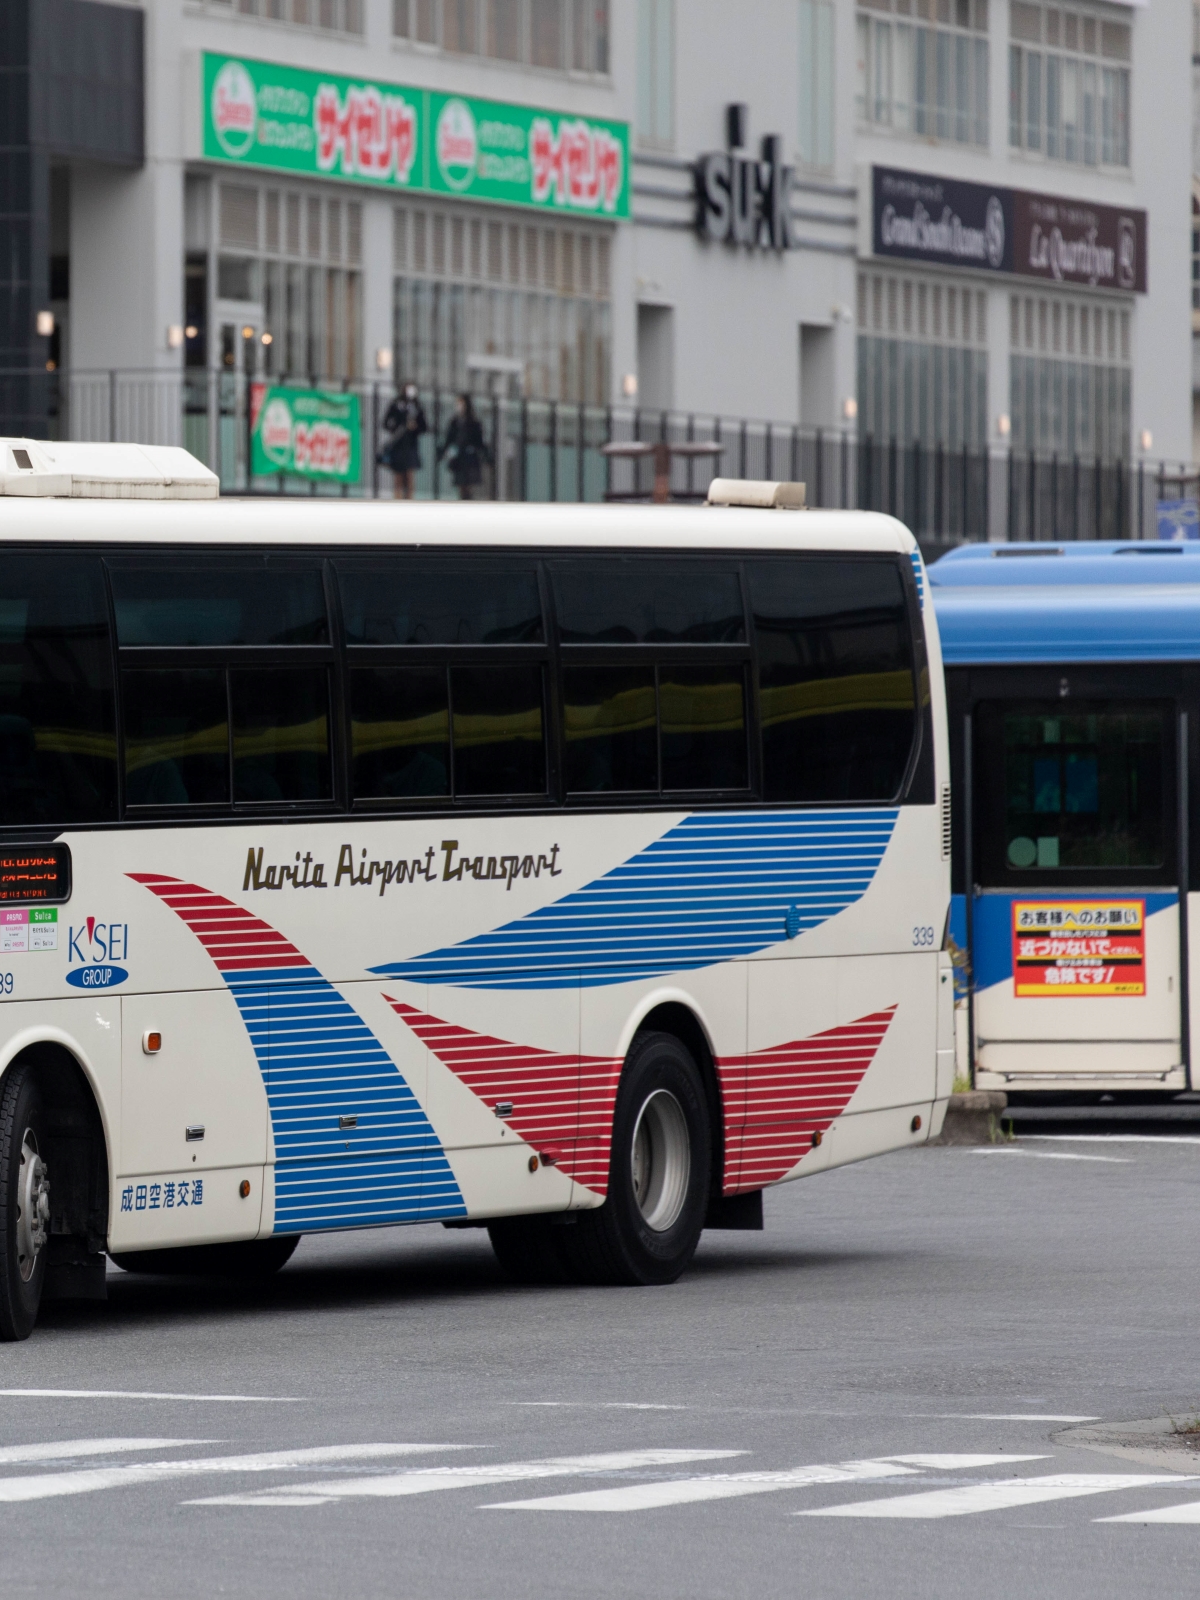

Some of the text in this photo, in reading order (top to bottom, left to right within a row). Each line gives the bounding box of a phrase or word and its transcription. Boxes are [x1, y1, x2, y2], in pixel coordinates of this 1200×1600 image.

[243, 839, 562, 896] Narita Airport Transport
[6, 913, 22, 921] PASMO
[34, 911, 52, 921] Suica
[1019, 908, 1139, 927] お客様へのお願い
[912, 926, 935, 946] 339
[1020, 939, 1111, 956] 近づかないで
[82, 968, 112, 986] GROUP
[120, 1179, 204, 1213] 成田空港交通
